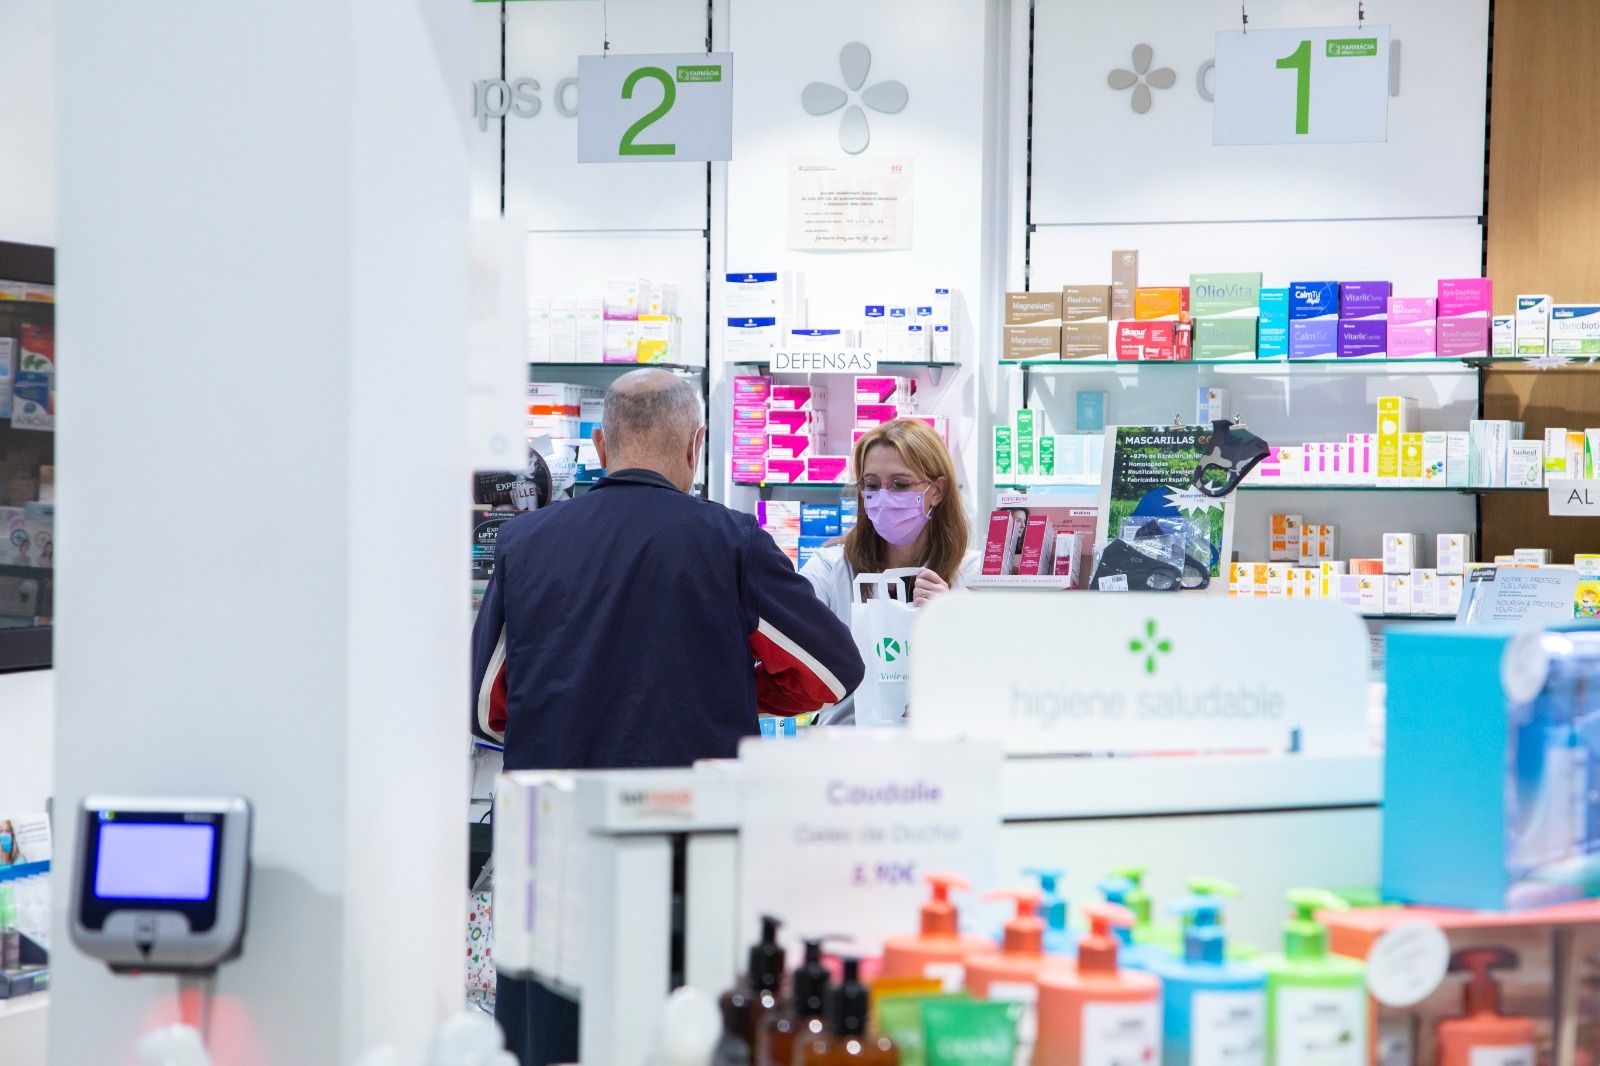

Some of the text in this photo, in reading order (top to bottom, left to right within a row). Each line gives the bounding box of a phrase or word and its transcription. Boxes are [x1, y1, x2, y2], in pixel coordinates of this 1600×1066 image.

[1275, 40, 1312, 134] 1
[619, 66, 676, 155] 2
[776, 353, 872, 369] DEFENSAS
[1125, 436, 1195, 445] MASCARILLAS
[1530, 577, 1561, 585] PROTEGE
[1008, 683, 1286, 726] higiene saludable
